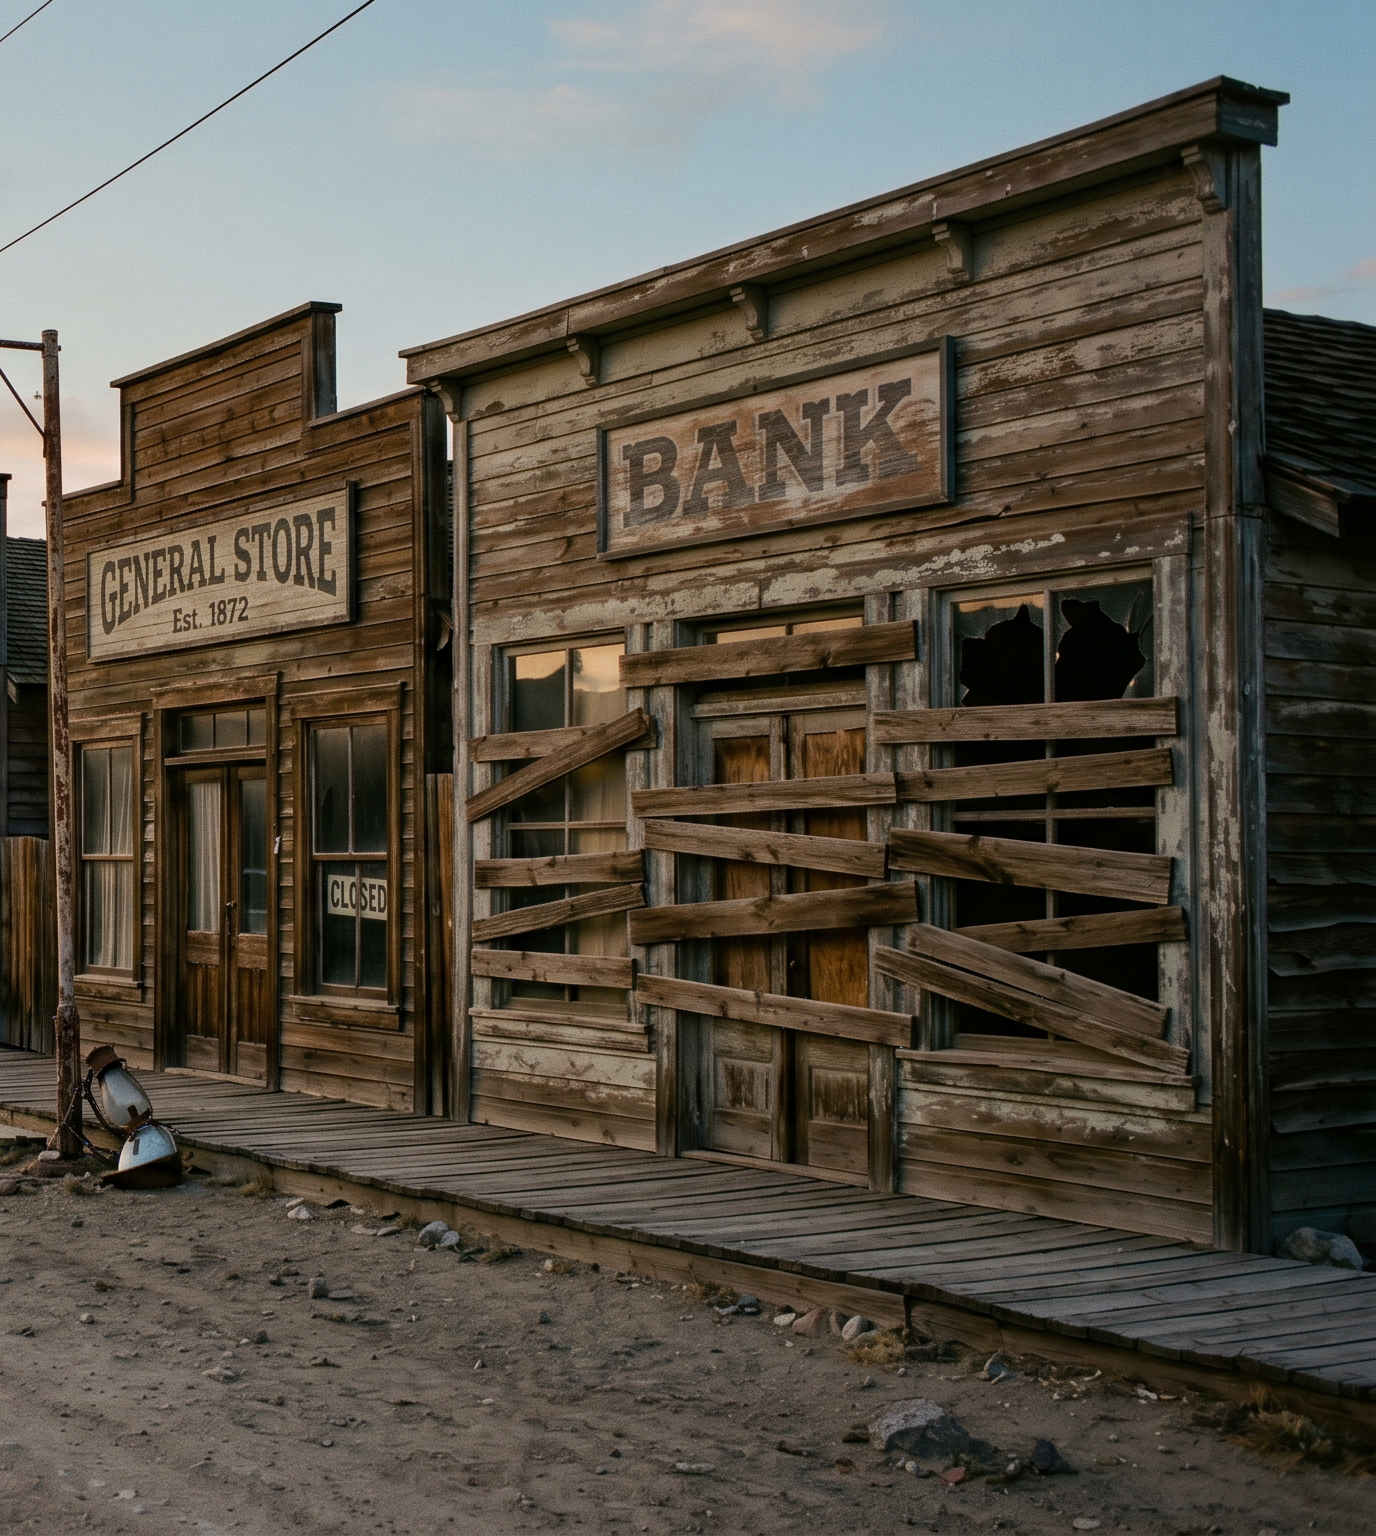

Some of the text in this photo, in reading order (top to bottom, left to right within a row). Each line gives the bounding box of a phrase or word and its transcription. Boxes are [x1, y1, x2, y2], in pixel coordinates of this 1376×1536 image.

[622, 377, 922, 528] BANK
[101, 506, 337, 635] GENERAL STORE
[173, 596, 249, 633] Est. 1872
[331, 879, 387, 913] CLOSED
